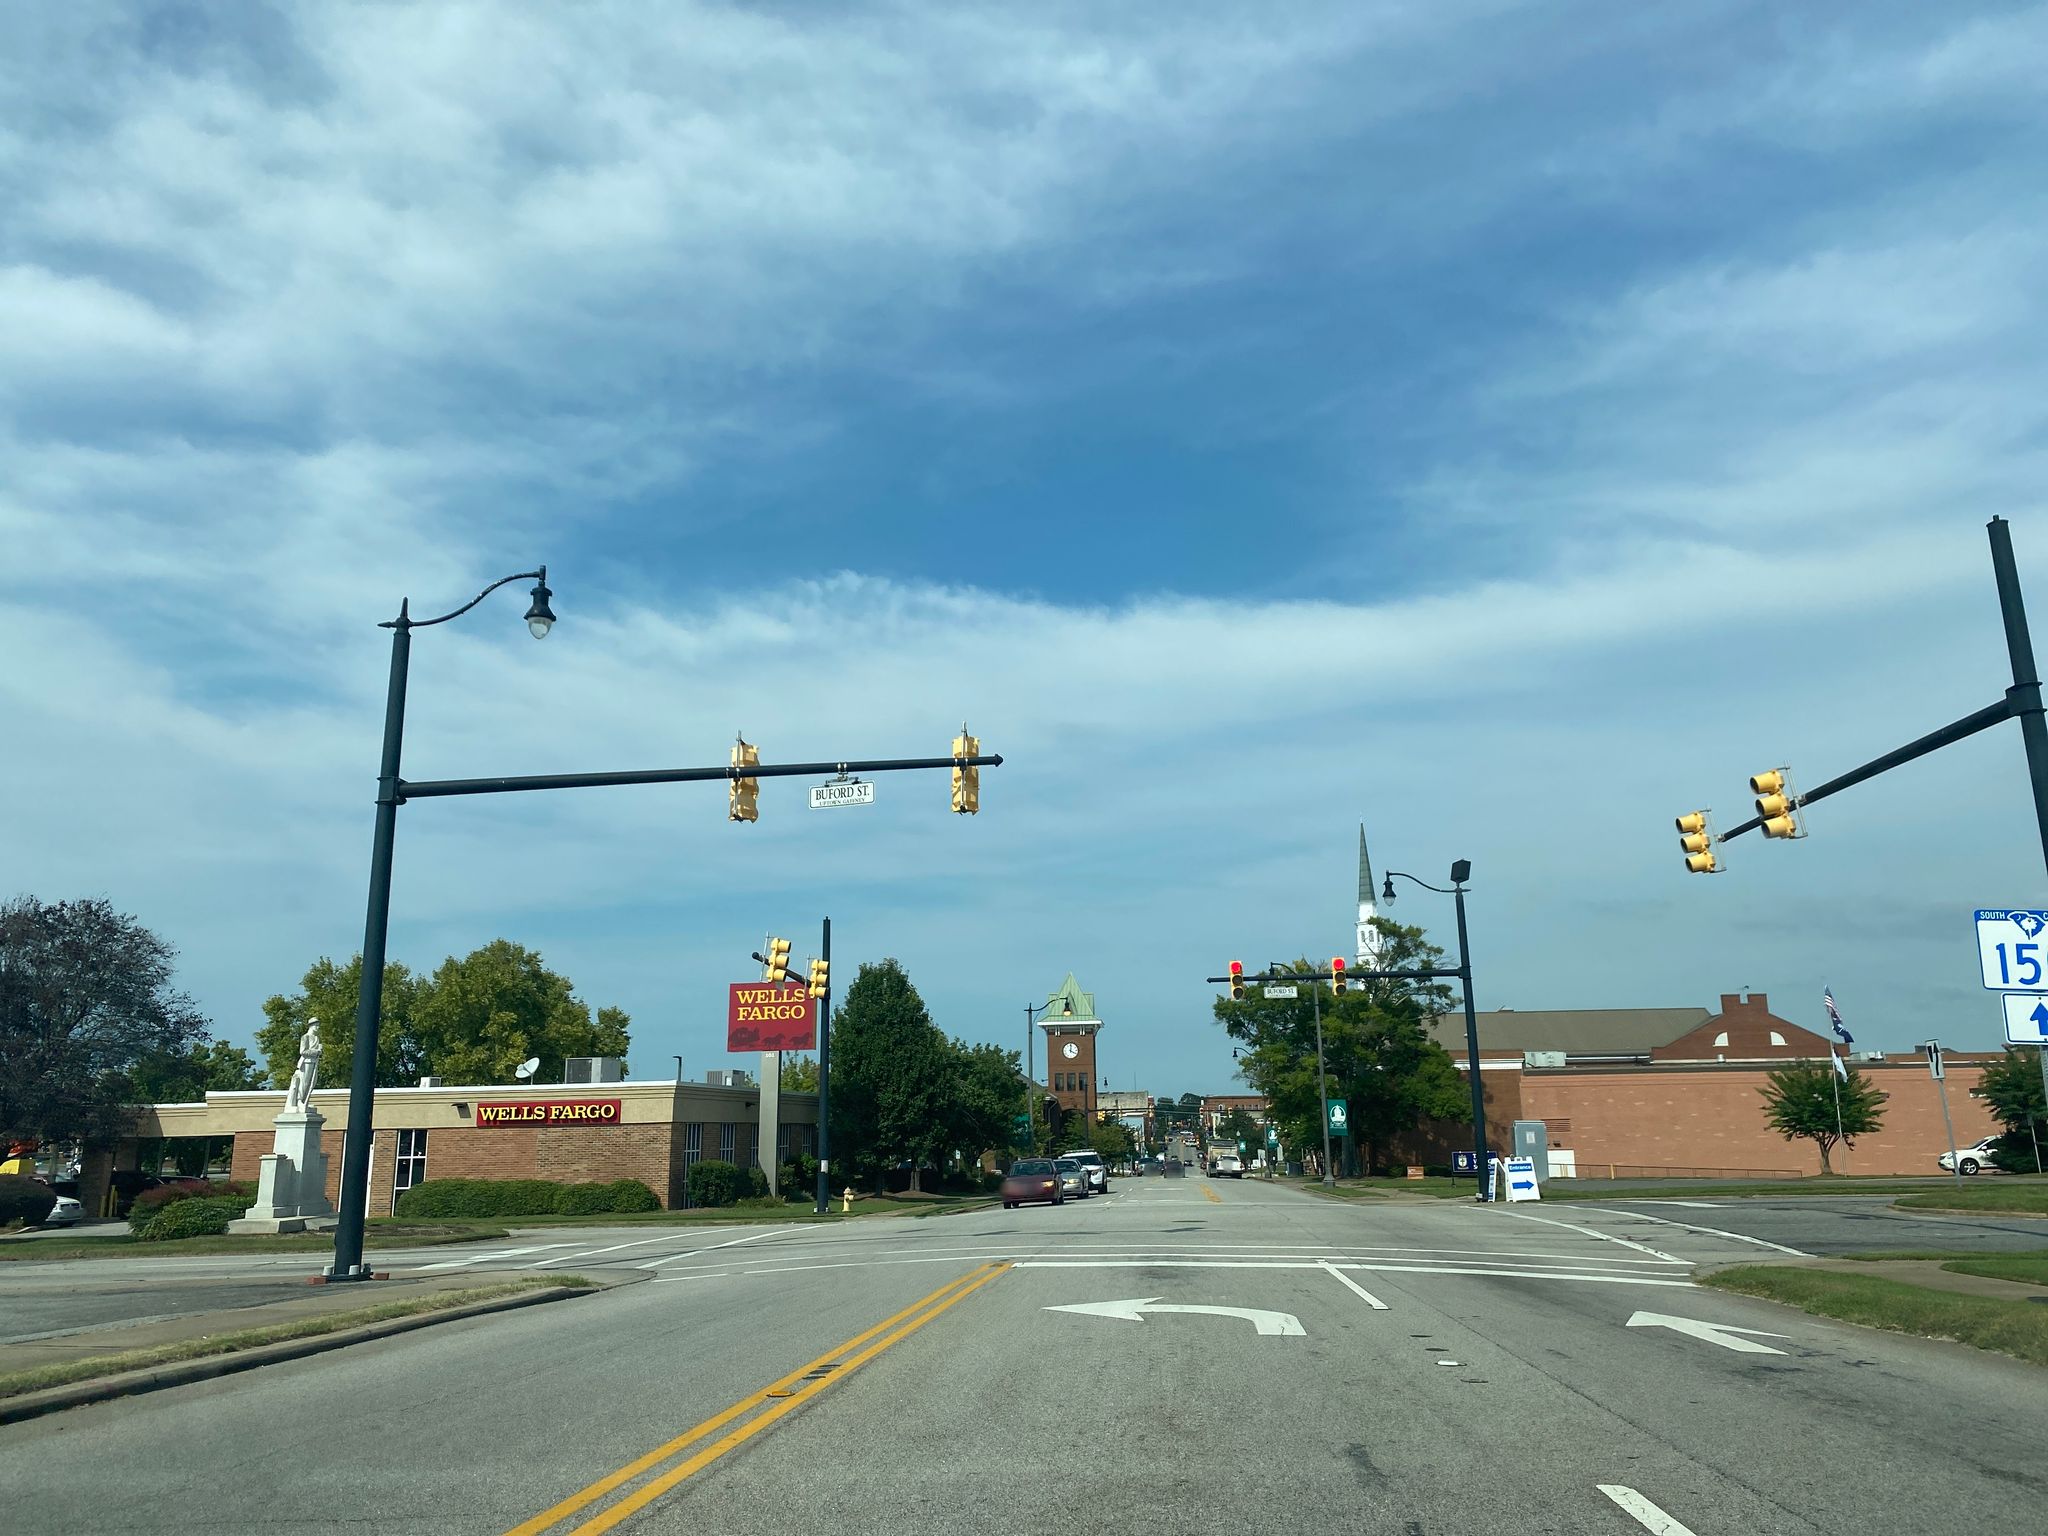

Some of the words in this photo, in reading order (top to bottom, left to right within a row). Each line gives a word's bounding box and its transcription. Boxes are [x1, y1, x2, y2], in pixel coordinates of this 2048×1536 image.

[815, 786, 854, 801] BUFORD
[857, 784, 870, 797] ST.
[1980, 911, 2006, 920] SOUTH
[1995, 943, 2048, 985] 15
[736, 989, 806, 1004] WELLS
[737, 1005, 806, 1021] FARGO
[479, 1106, 546, 1121] WELLS
[549, 1104, 615, 1119] FARGO
